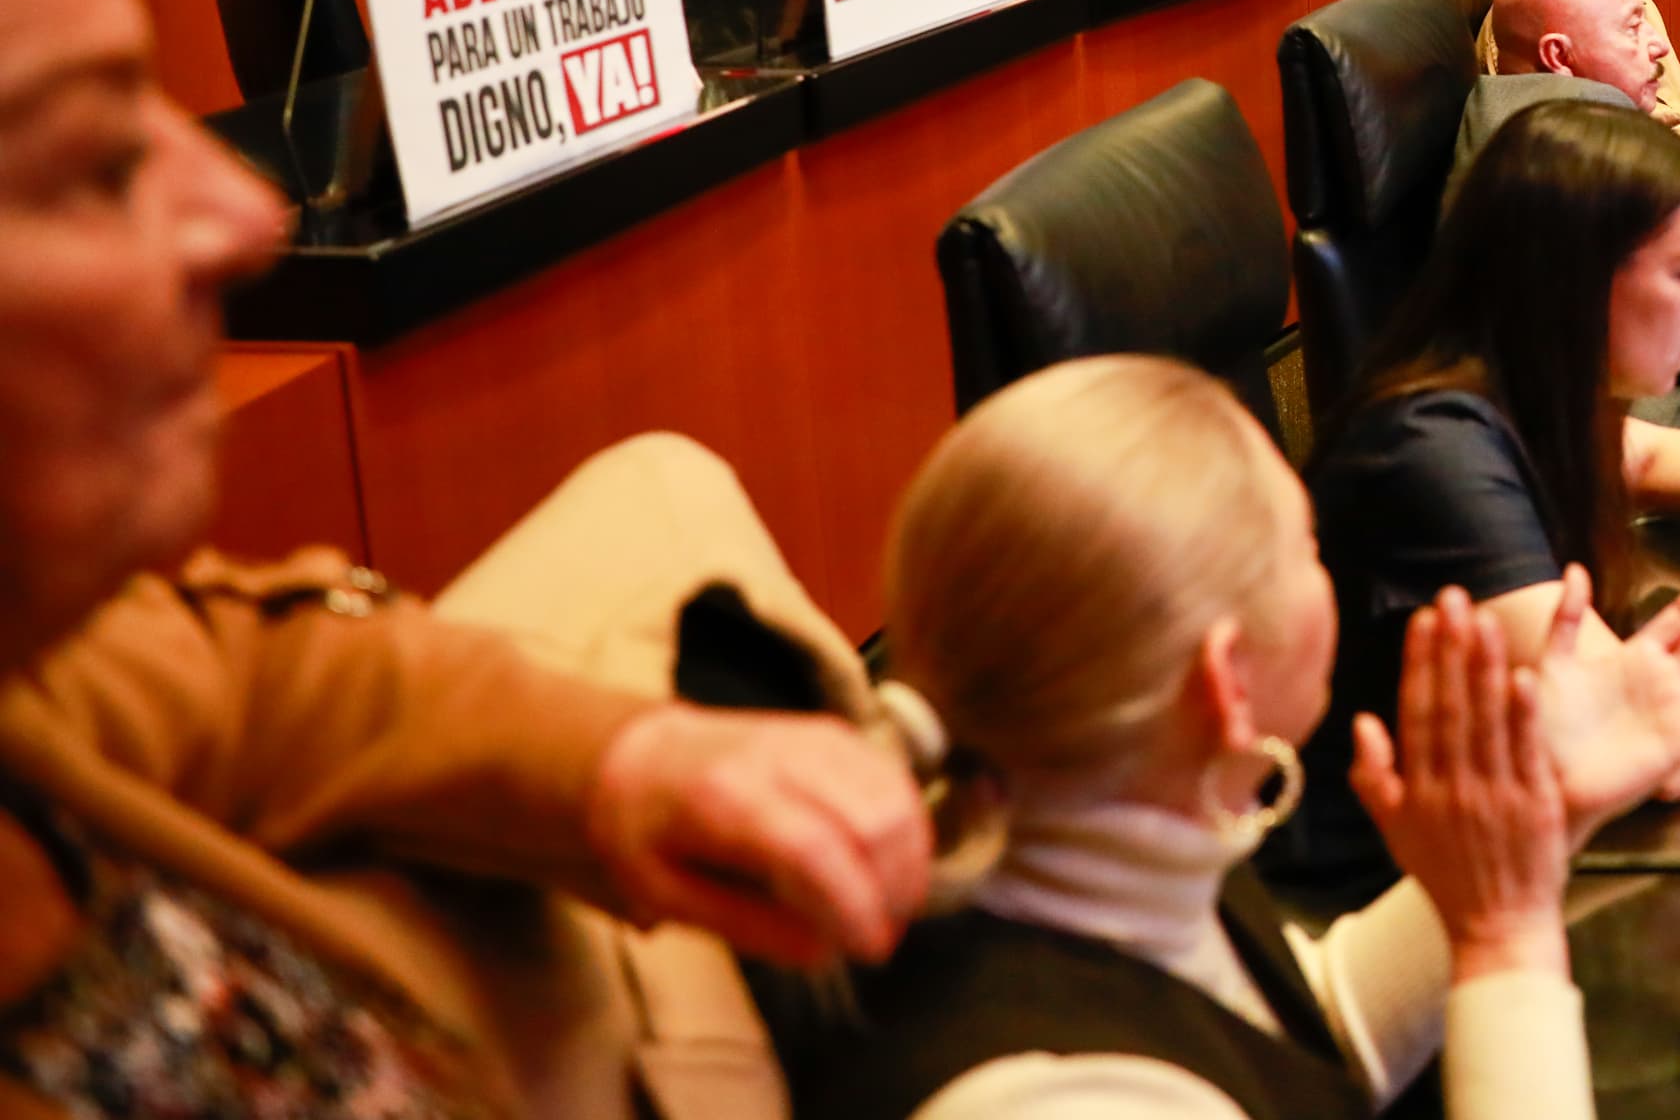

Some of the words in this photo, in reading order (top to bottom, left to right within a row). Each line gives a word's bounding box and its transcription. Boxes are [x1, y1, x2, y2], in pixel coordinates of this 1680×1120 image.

[427, 17, 500, 82] PARA
[503, 4, 540, 59] UN
[440, 72, 564, 172] DIGNO,
[566, 37, 654, 125] YA!
